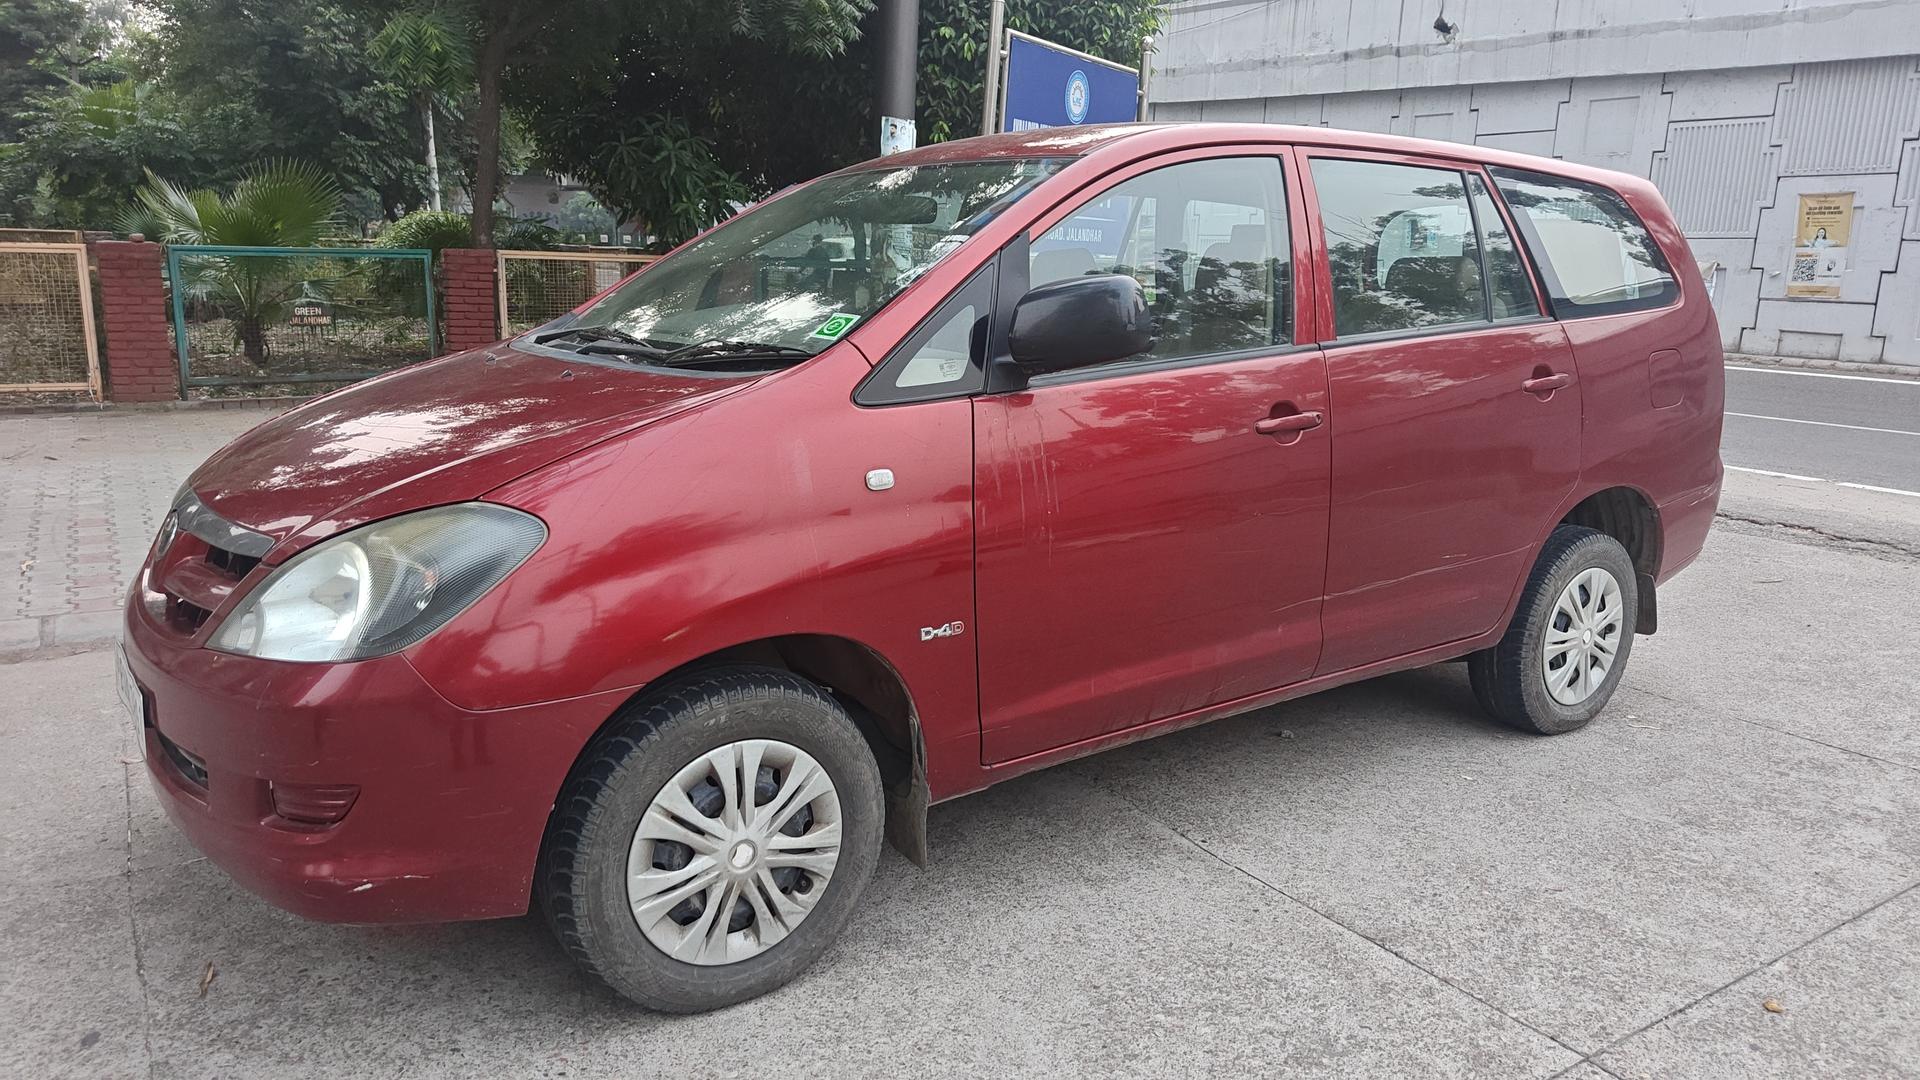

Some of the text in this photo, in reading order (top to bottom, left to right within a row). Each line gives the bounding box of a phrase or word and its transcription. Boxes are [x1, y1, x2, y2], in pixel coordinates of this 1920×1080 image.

[1066, 227, 1102, 242] JALANDHAR
[294, 307, 322, 316] GREEN
[289, 316, 332, 325] JALANDHAR
[921, 621, 965, 641] D-4D
